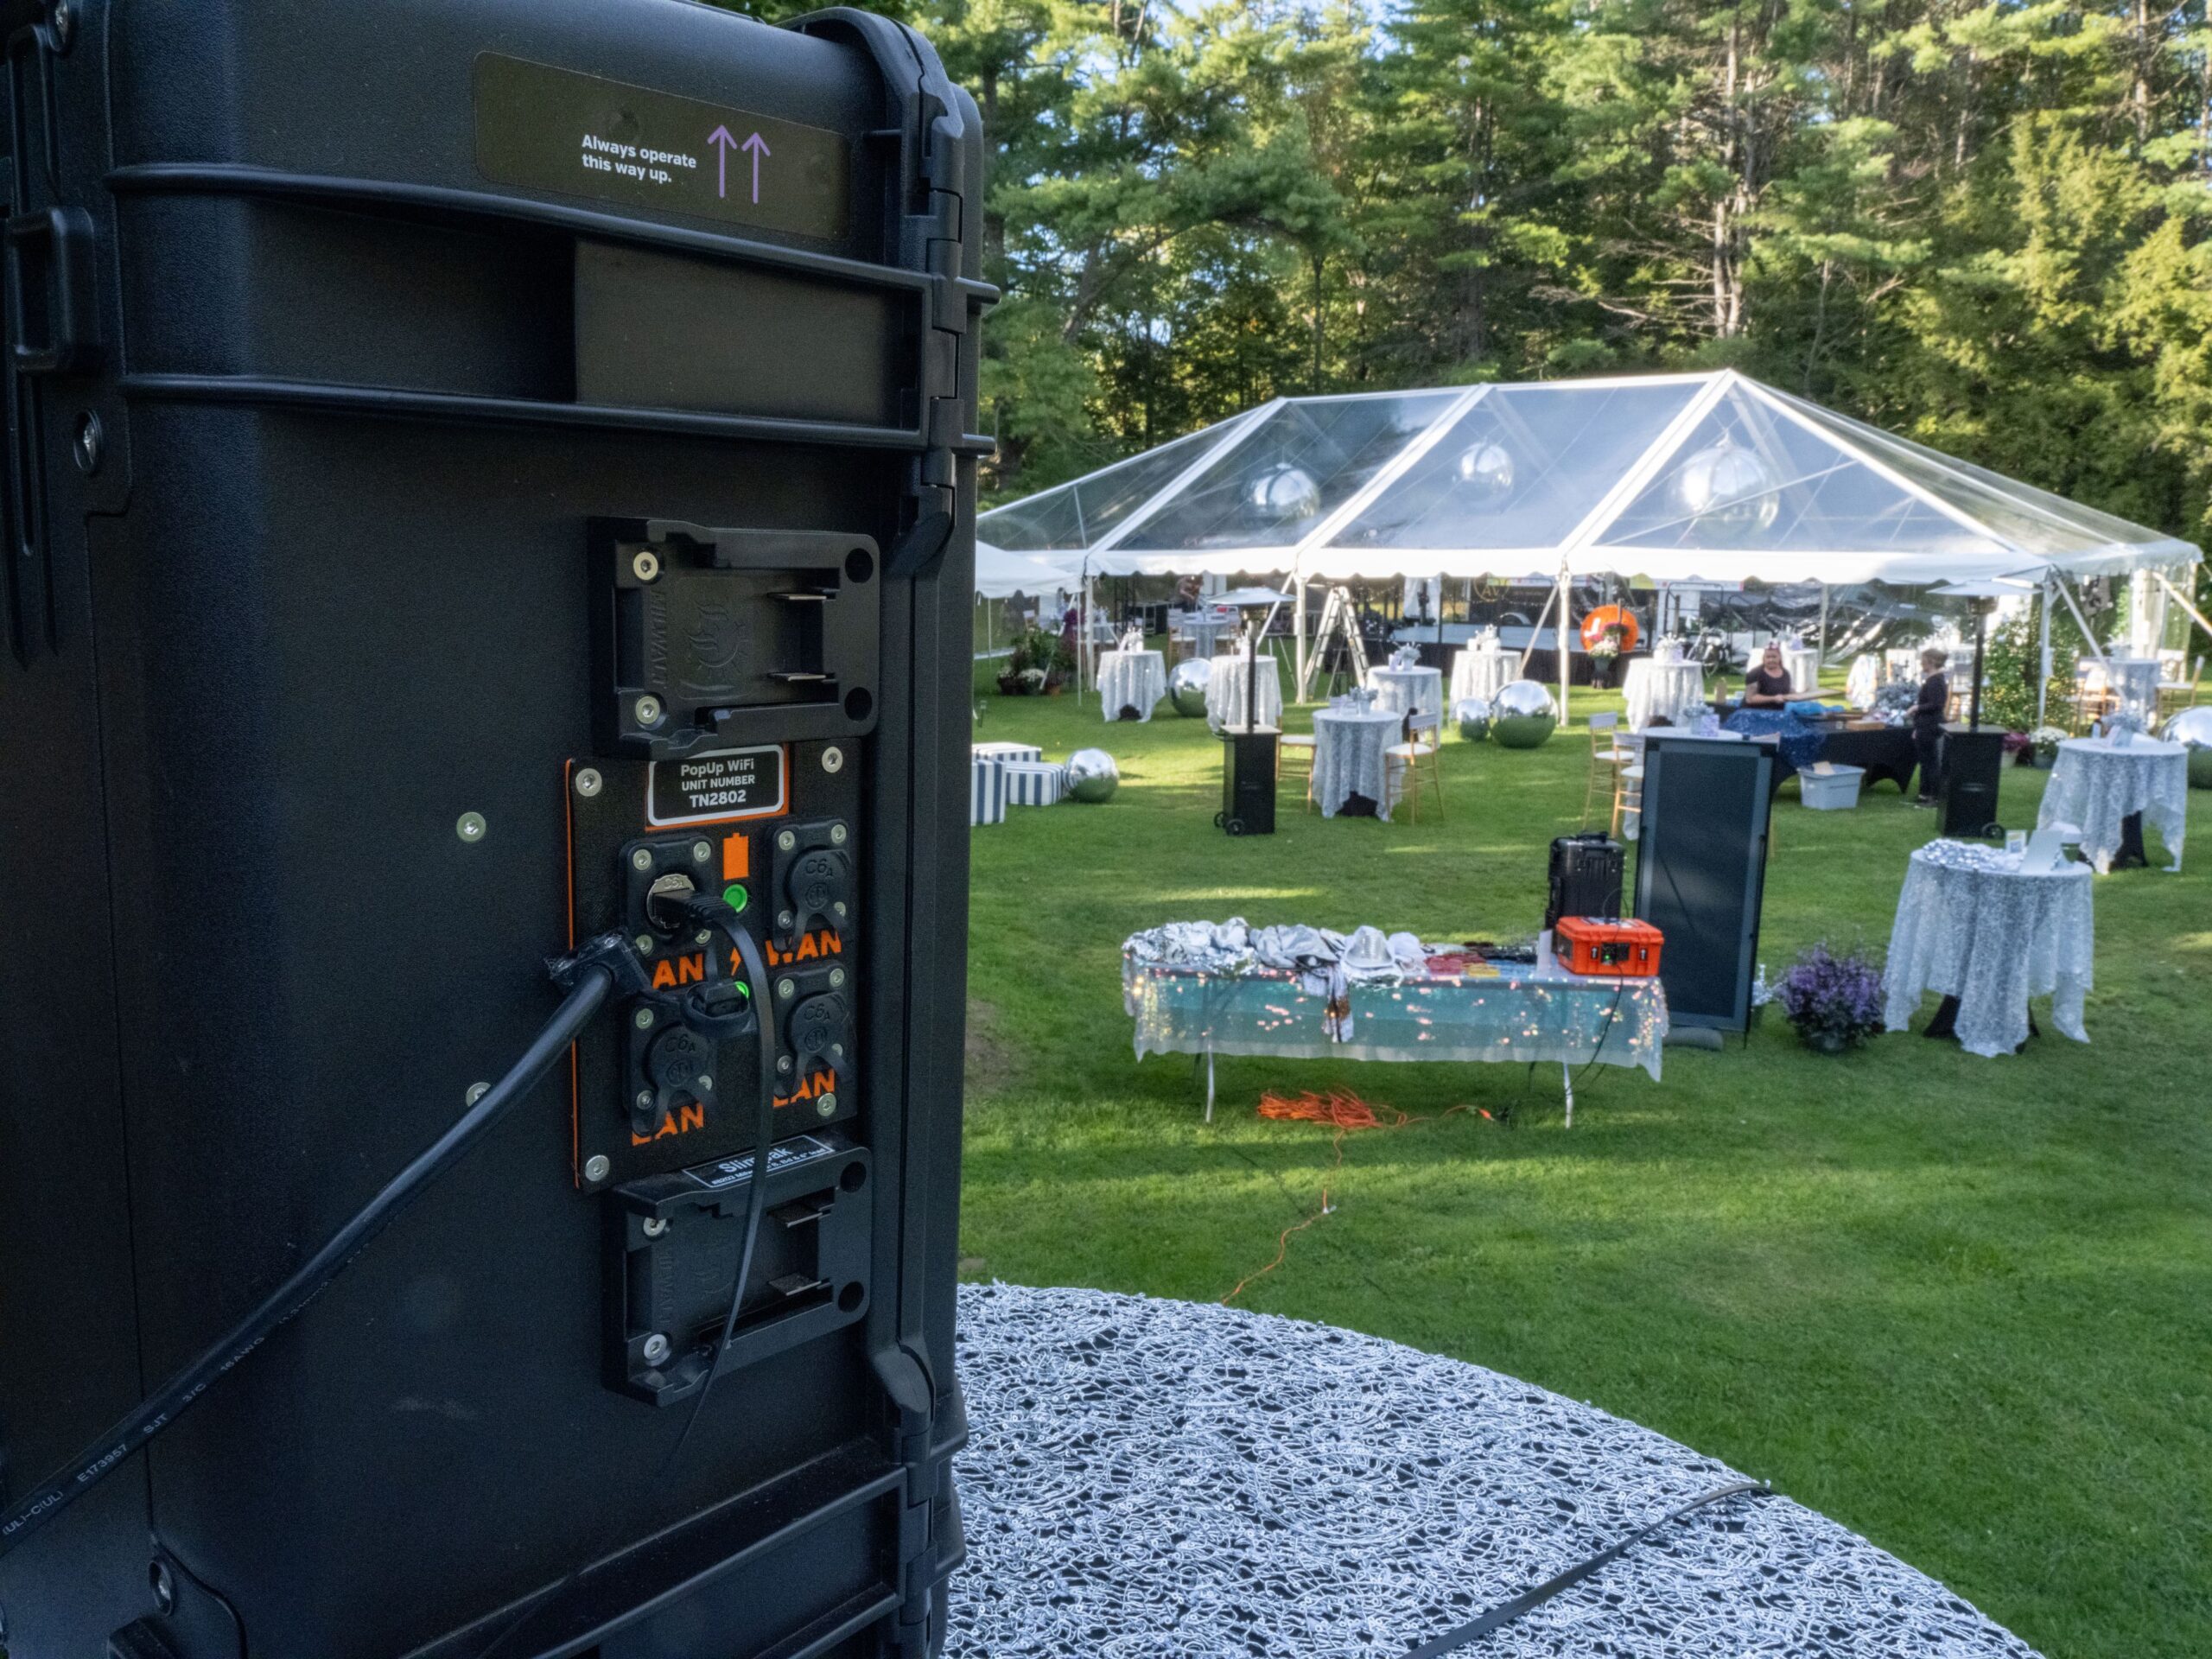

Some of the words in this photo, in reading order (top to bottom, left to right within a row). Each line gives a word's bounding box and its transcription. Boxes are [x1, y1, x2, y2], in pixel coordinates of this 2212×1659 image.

[582, 134, 637, 159] Always
[639, 148, 696, 168] operate
[582, 154, 612, 171] this
[615, 162, 645, 181] way
[649, 168, 672, 184] up.
[681, 761, 724, 778] PopUp
[727, 758, 754, 772] WiFi
[681, 779, 708, 791] UNIT
[709, 774, 755, 788] NUMBER
[689, 789, 747, 808] TN2802
[652, 954, 703, 989] AN
[76, 1444, 128, 1483] E173957
[143, 1413, 168, 1434] SJT
